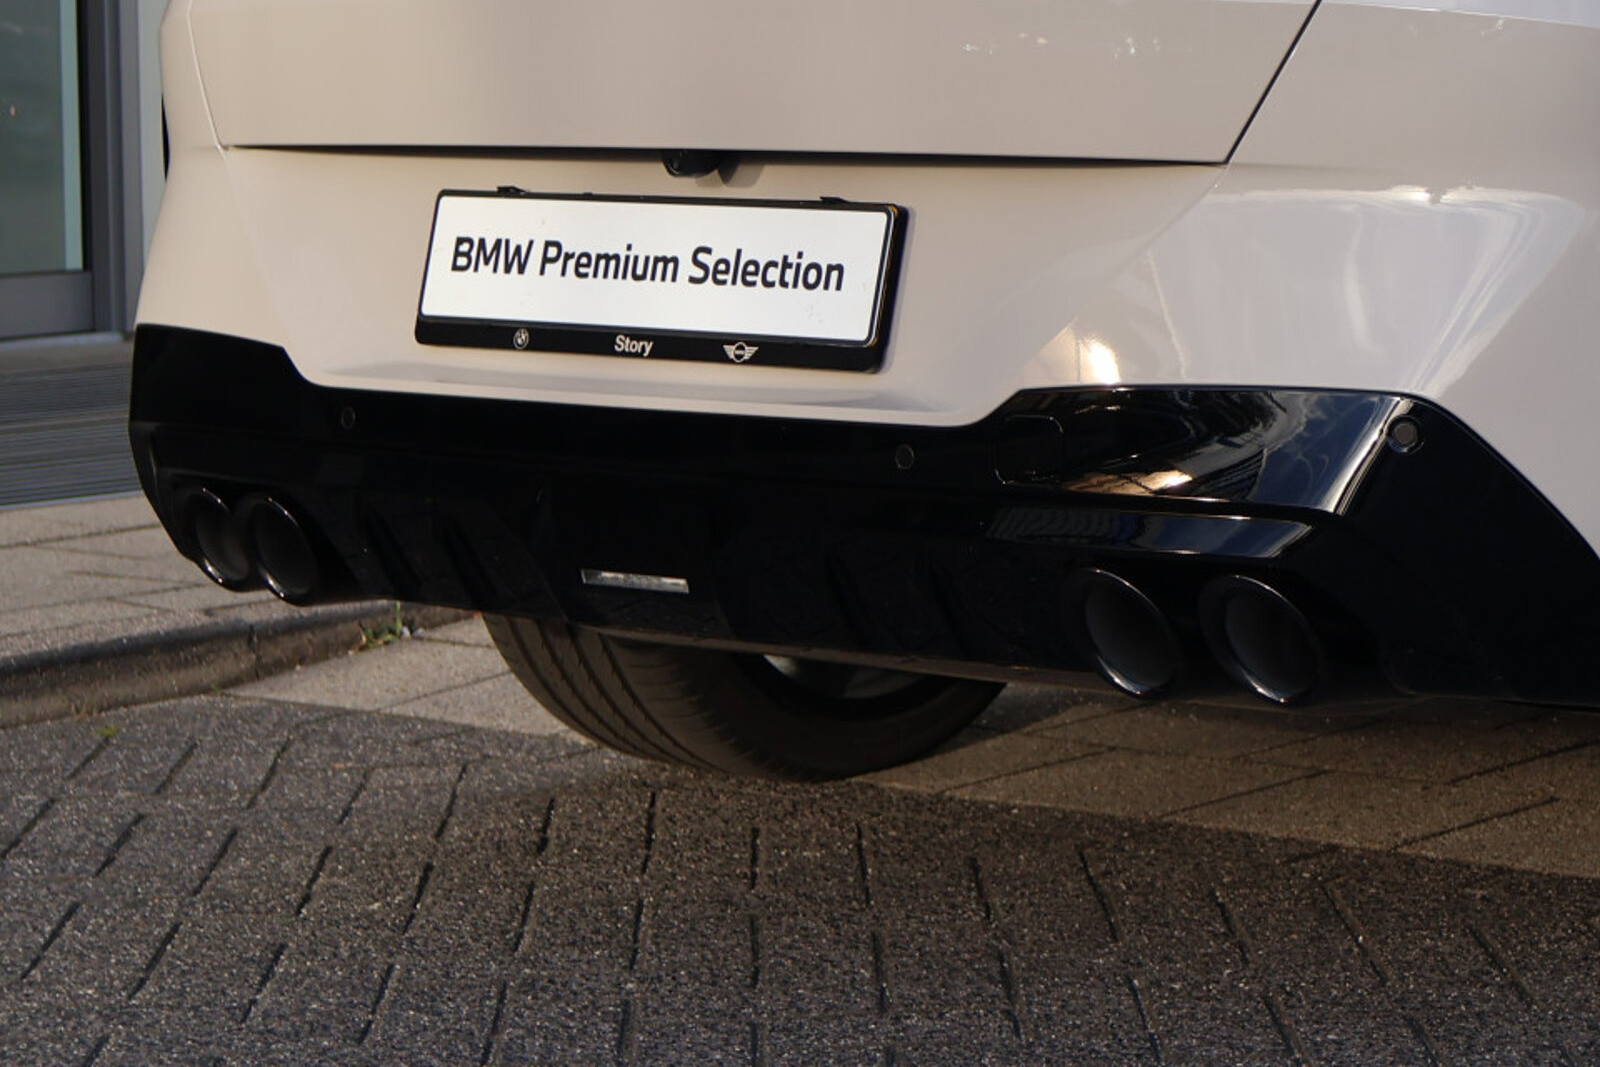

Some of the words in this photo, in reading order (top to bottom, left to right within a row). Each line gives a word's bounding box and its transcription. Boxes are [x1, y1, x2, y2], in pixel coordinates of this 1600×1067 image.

[450, 236, 535, 276] BMW
[538, 239, 680, 284] Premium
[687, 246, 845, 292] Selection
[613, 334, 653, 358] Story
